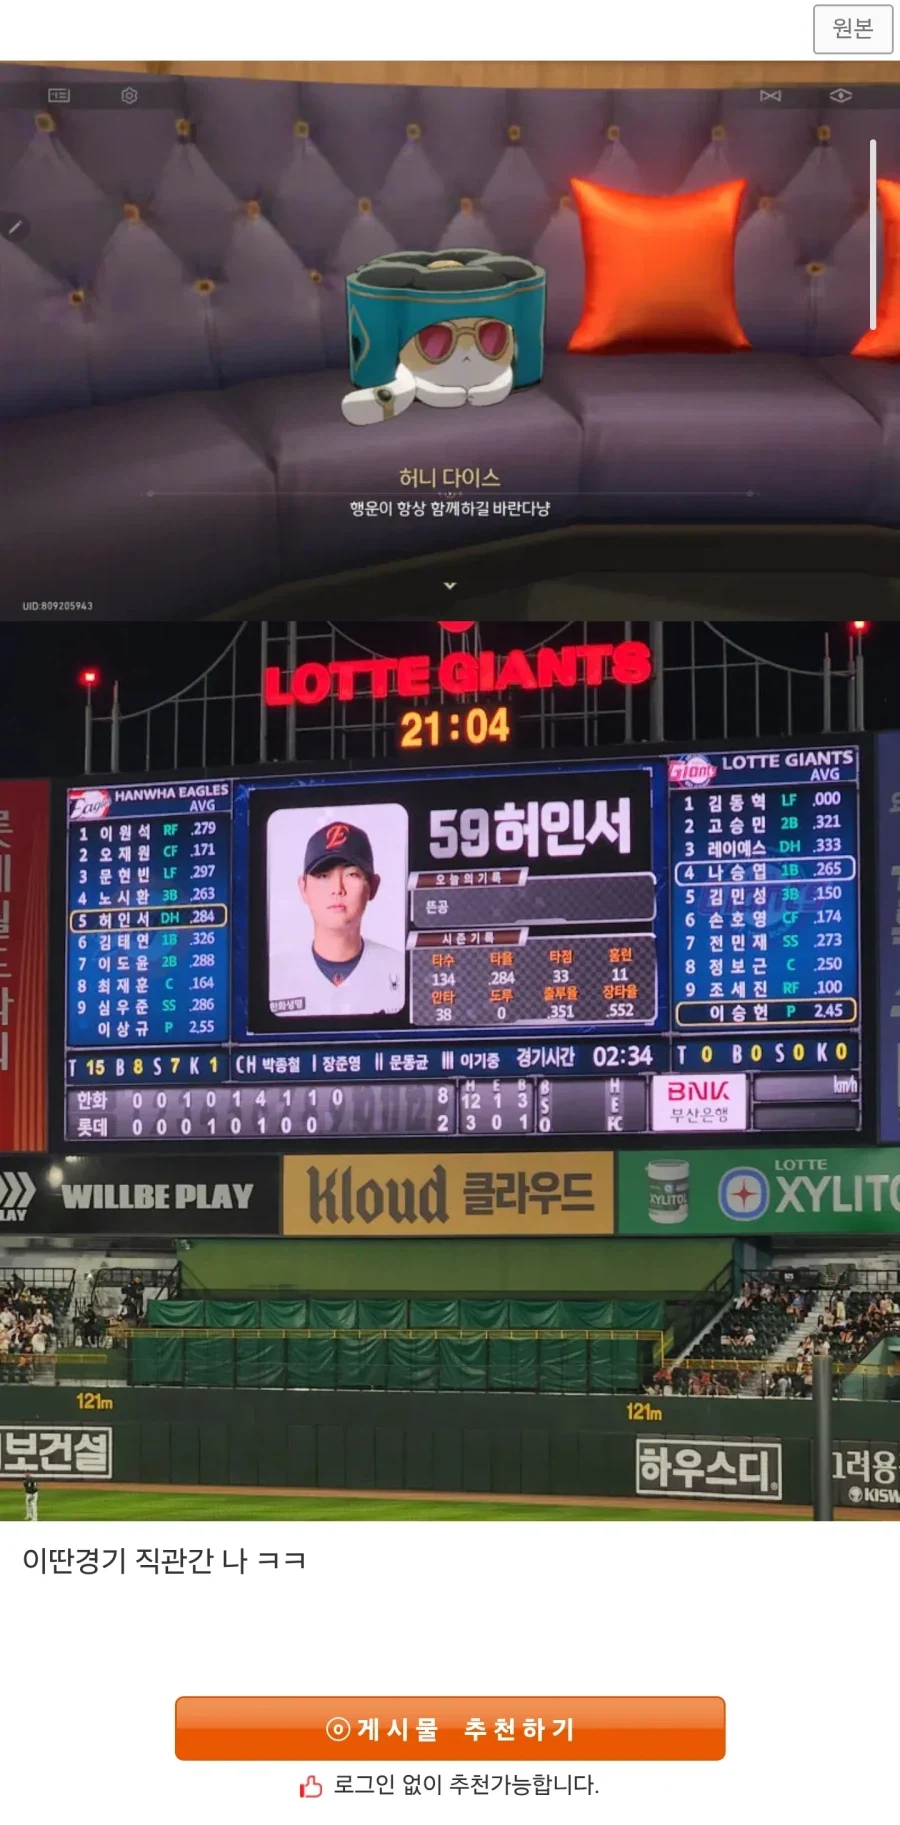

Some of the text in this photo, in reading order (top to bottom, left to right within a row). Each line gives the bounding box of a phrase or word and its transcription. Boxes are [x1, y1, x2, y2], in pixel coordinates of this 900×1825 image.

[265, 640, 651, 706] LOTTE GIANTS
[400, 706, 510, 748] 21:04
[722, 750, 854, 770] LOTTE GIANTS
[810, 768, 840, 781] AVG
[115, 784, 229, 802] HANWHA EAGLES
[685, 797, 694, 811] 1
[782, 794, 796, 806] LF
[812, 791, 841, 807] .000
[190, 800, 216, 812] AVG
[80, 827, 88, 841] 1
[163, 824, 178, 836] RF
[191, 821, 216, 836] .279
[685, 818, 694, 833] 2
[781, 817, 798, 829] 2B
[812, 815, 841, 830] .321
[79, 848, 88, 862] 2
[163, 845, 178, 857] CF
[190, 843, 216, 857] .171
[685, 838, 841, 858] 3 레이예스 DH .333
[79, 870, 87, 884] 3
[163, 867, 177, 879] LF
[190, 865, 216, 879] .297
[684, 865, 694, 880] 4
[781, 864, 798, 876] 1B
[812, 862, 842, 877] .265
[78, 892, 87, 905] 4
[162, 889, 178, 901] 3B
[190, 887, 215, 902] .263
[686, 889, 694, 904] 5
[782, 888, 799, 901] 3B
[813, 886, 842, 901] .150
[426, 900, 448, 914] 뜬공
[78, 914, 86, 928] 5
[161, 911, 179, 923] DH
[190, 909, 215, 924] .284
[685, 913, 695, 927] 6
[782, 911, 798, 924] CF
[813, 910, 842, 924] .174
[78, 935, 87, 949] 6
[162, 934, 177, 946] 1B
[190, 931, 215, 946] .326
[686, 936, 695, 950] 7
[783, 935, 798, 948] SS
[813, 933, 842, 948] .273
[78, 957, 87, 971] 7
[162, 955, 177, 967] 2B
[189, 954, 215, 968] .288
[432, 947, 632, 967] 타수 타율 타점 홈런
[685, 959, 695, 974] 8
[786, 958, 796, 970] C
[814, 957, 842, 971] .250
[78, 979, 87, 993] 8
[165, 978, 174, 990] C
[189, 976, 214, 990] .164
[432, 968, 628, 986] 134 .284 33 11
[432, 984, 638, 1005] 안타 도루 출루율 장타율
[686, 982, 695, 997] 9
[783, 982, 799, 994] RF
[814, 980, 842, 995] .100
[78, 1000, 86, 1014] 9
[162, 1000, 176, 1011] SS
[189, 998, 214, 1012] .286
[436, 1004, 634, 1022] 38 .351 .552
[787, 1005, 796, 1017] P
[814, 1004, 843, 1018] 2.45
[165, 1022, 173, 1033] P
[189, 1020, 214, 1034] 2.55
[236, 1044, 653, 1074] CH 박종철 장준영 문동균 이기중 경기시간 02:34
[668, 1081, 730, 1101] BNK
[833, 1074, 858, 1094] km/h
[77, 1090, 108, 1110] 한화
[670, 1107, 728, 1124] 부산은행
[77, 1118, 108, 1137] 롯데
[774, 1159, 828, 1171] LOTTE
[61, 1183, 254, 1209] WILLBE PLAY
[306, 1164, 595, 1224] Kloud 클라우드
[649, 1192, 687, 1206] XYLITOL
[76, 1392, 114, 1410] 121m
[626, 1402, 662, 1420] 121m
[0, 1432, 107, 1472] 보건설
